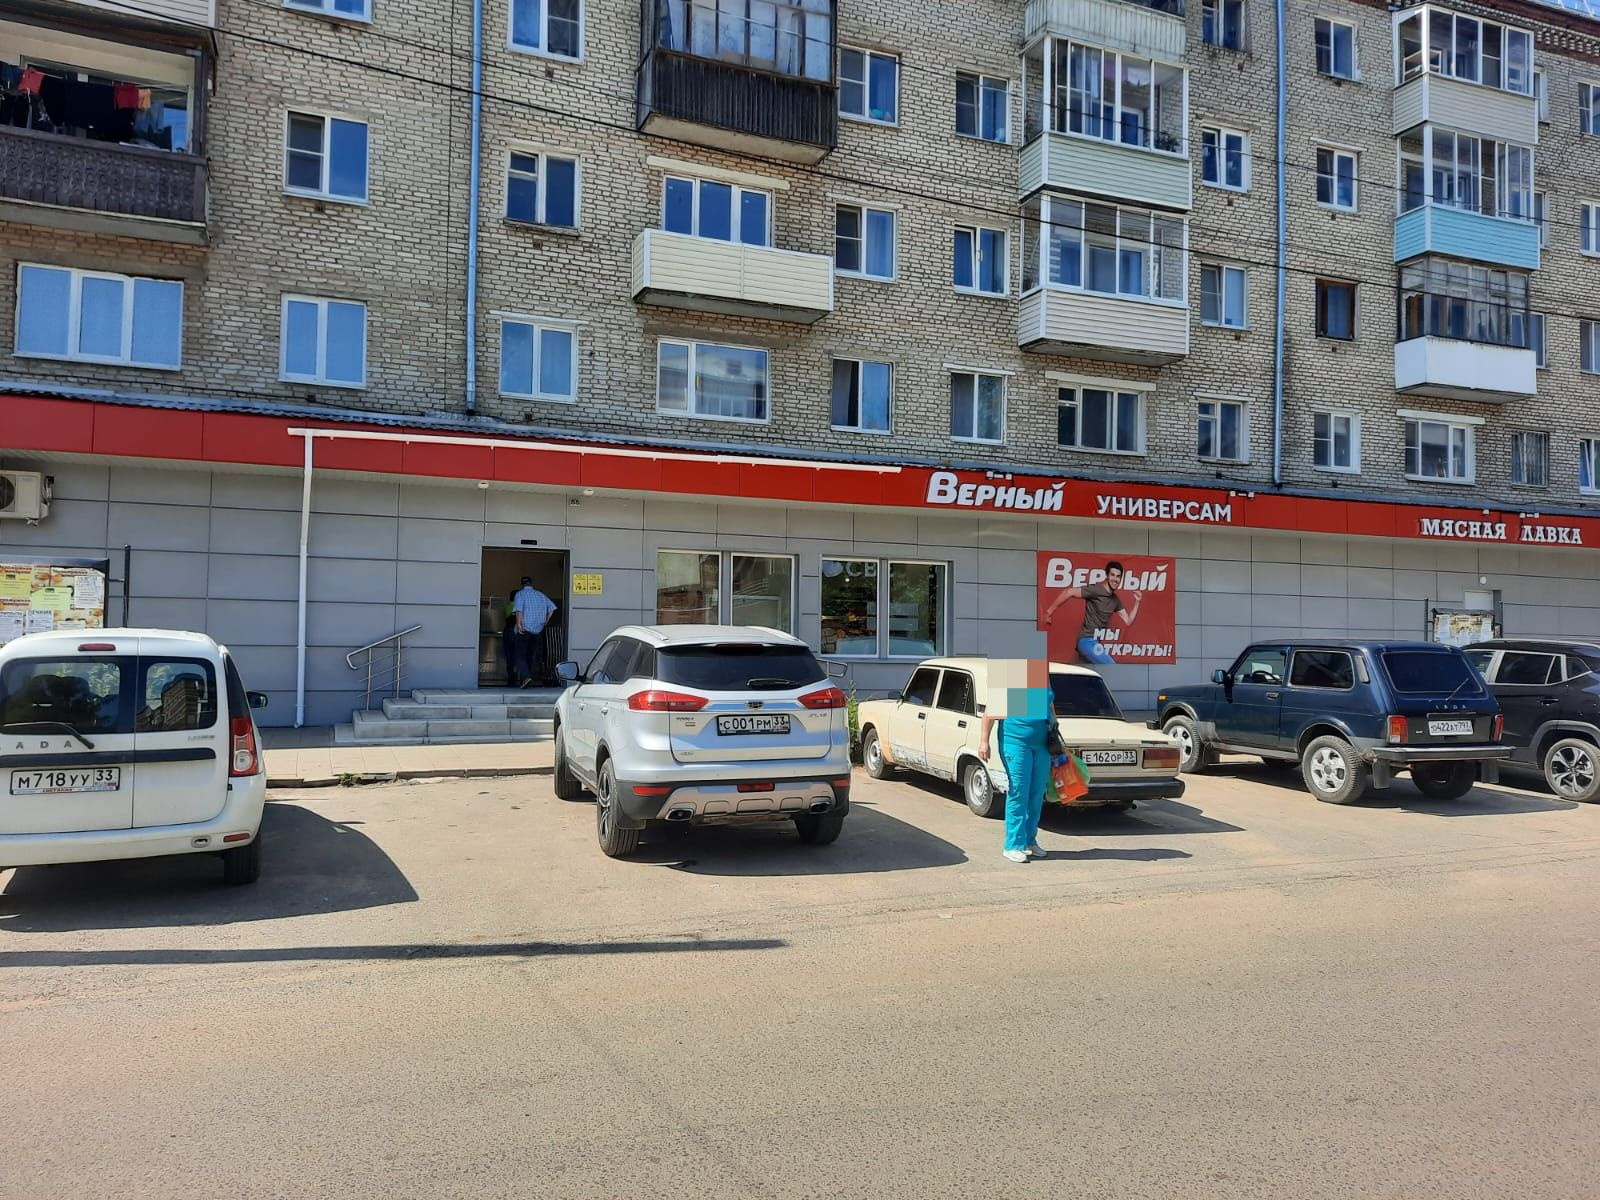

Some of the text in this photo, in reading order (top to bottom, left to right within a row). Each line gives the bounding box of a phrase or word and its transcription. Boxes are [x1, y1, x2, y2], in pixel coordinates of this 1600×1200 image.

[1097, 495, 1232, 522] УНИВЕРСАМ
[1420, 518, 1583, 545] МЯСНАЯ ЛАВКА
[1093, 628, 1121, 641] МЫ
[1093, 643, 1173, 657] ОТКРЫТЫ!
[96, 769, 113, 782] 33
